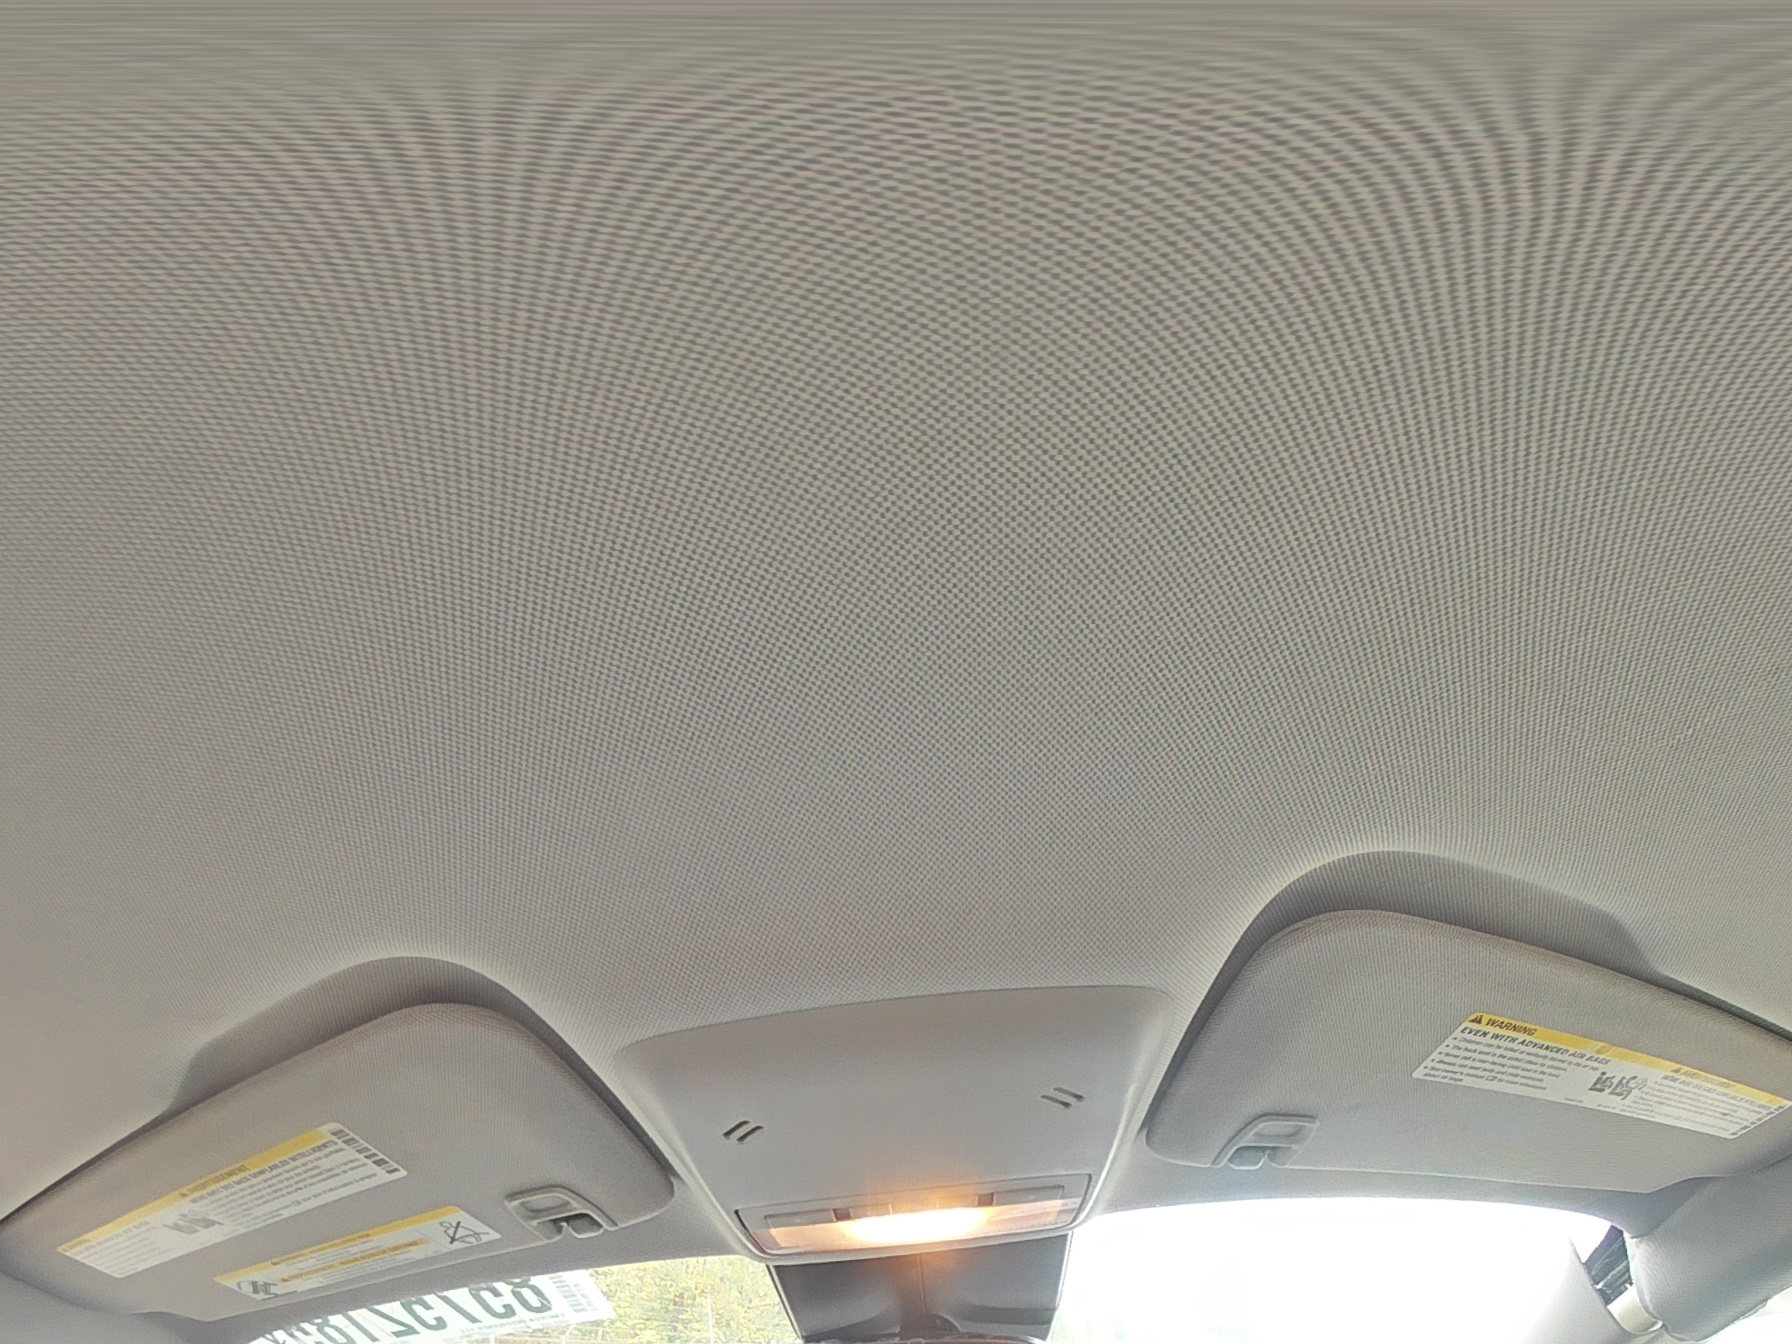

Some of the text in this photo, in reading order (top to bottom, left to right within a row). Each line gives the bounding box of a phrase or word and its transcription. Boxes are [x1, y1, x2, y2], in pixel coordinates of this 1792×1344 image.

[1485, 1017, 1538, 1037] WARNING
[1460, 1026, 1490, 1038] EVEN
[1490, 1032, 1519, 1044] WITH
[1517, 1039, 1570, 1055] ADVANCED
[1568, 1051, 1587, 1060] AIR
